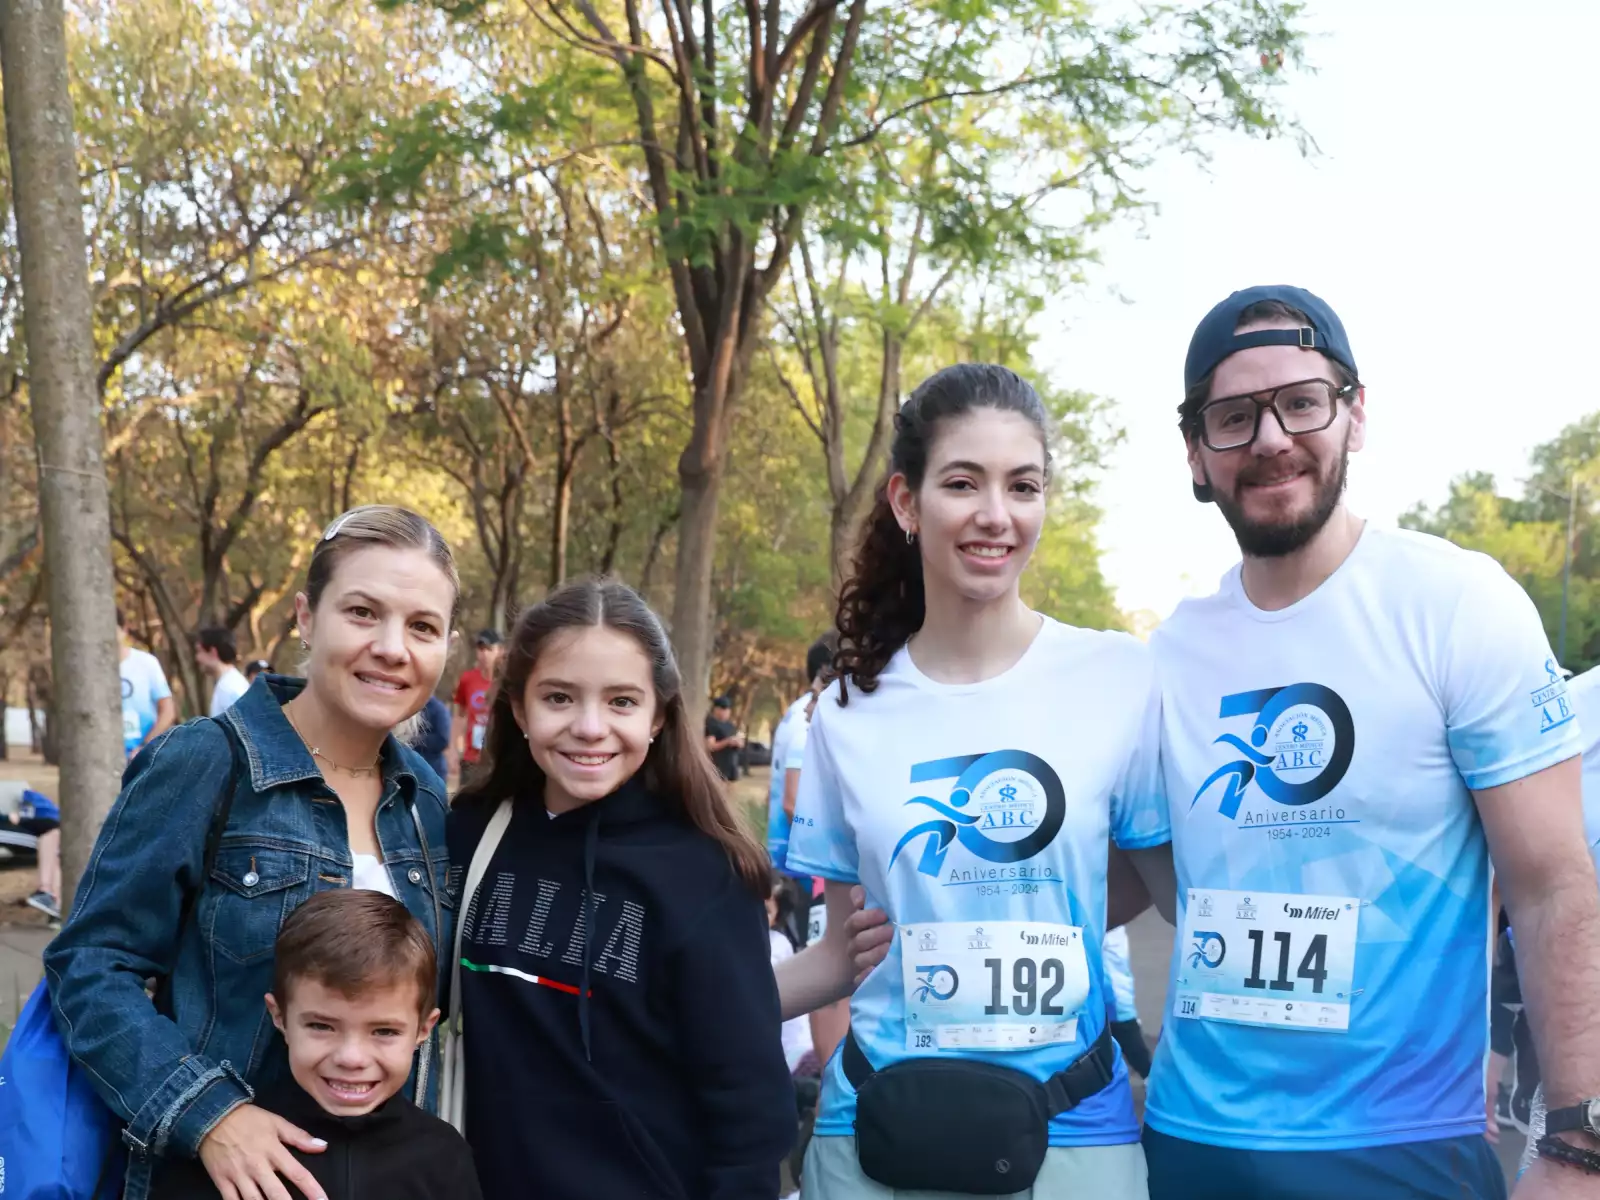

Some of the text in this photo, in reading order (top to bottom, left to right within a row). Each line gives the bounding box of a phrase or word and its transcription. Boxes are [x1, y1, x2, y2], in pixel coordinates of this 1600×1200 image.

[1276, 751, 1321, 768] ABC
[982, 811, 1033, 828] ABC
[1244, 806, 1346, 825] Aniversario
[950, 866, 1053, 881] Aniversario
[1304, 906, 1341, 921] Mifel
[1041, 933, 1069, 946] Mifel
[1244, 929, 1328, 994] 114
[984, 957, 1065, 1016] 192
[1181, 1001, 1196, 1015] 114
[915, 1035, 932, 1048] 192
